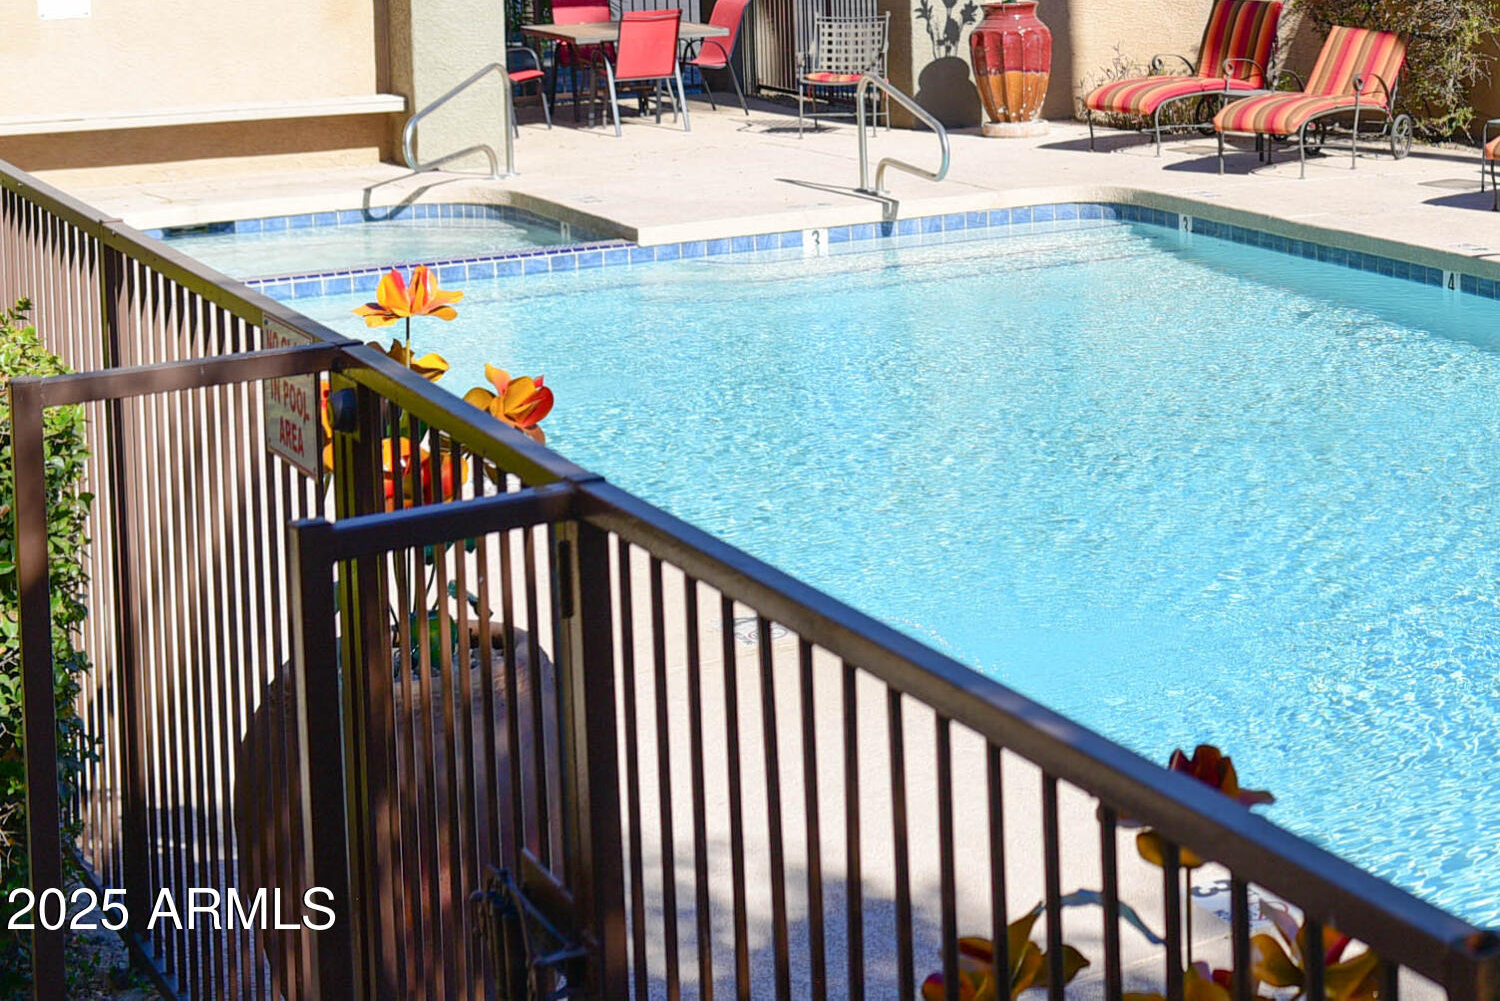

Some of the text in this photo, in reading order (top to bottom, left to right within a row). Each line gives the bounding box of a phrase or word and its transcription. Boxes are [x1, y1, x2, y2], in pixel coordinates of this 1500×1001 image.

[1447, 272, 1455, 290] 4
[283, 380, 310, 422] POOL
[280, 416, 304, 458] AREA
